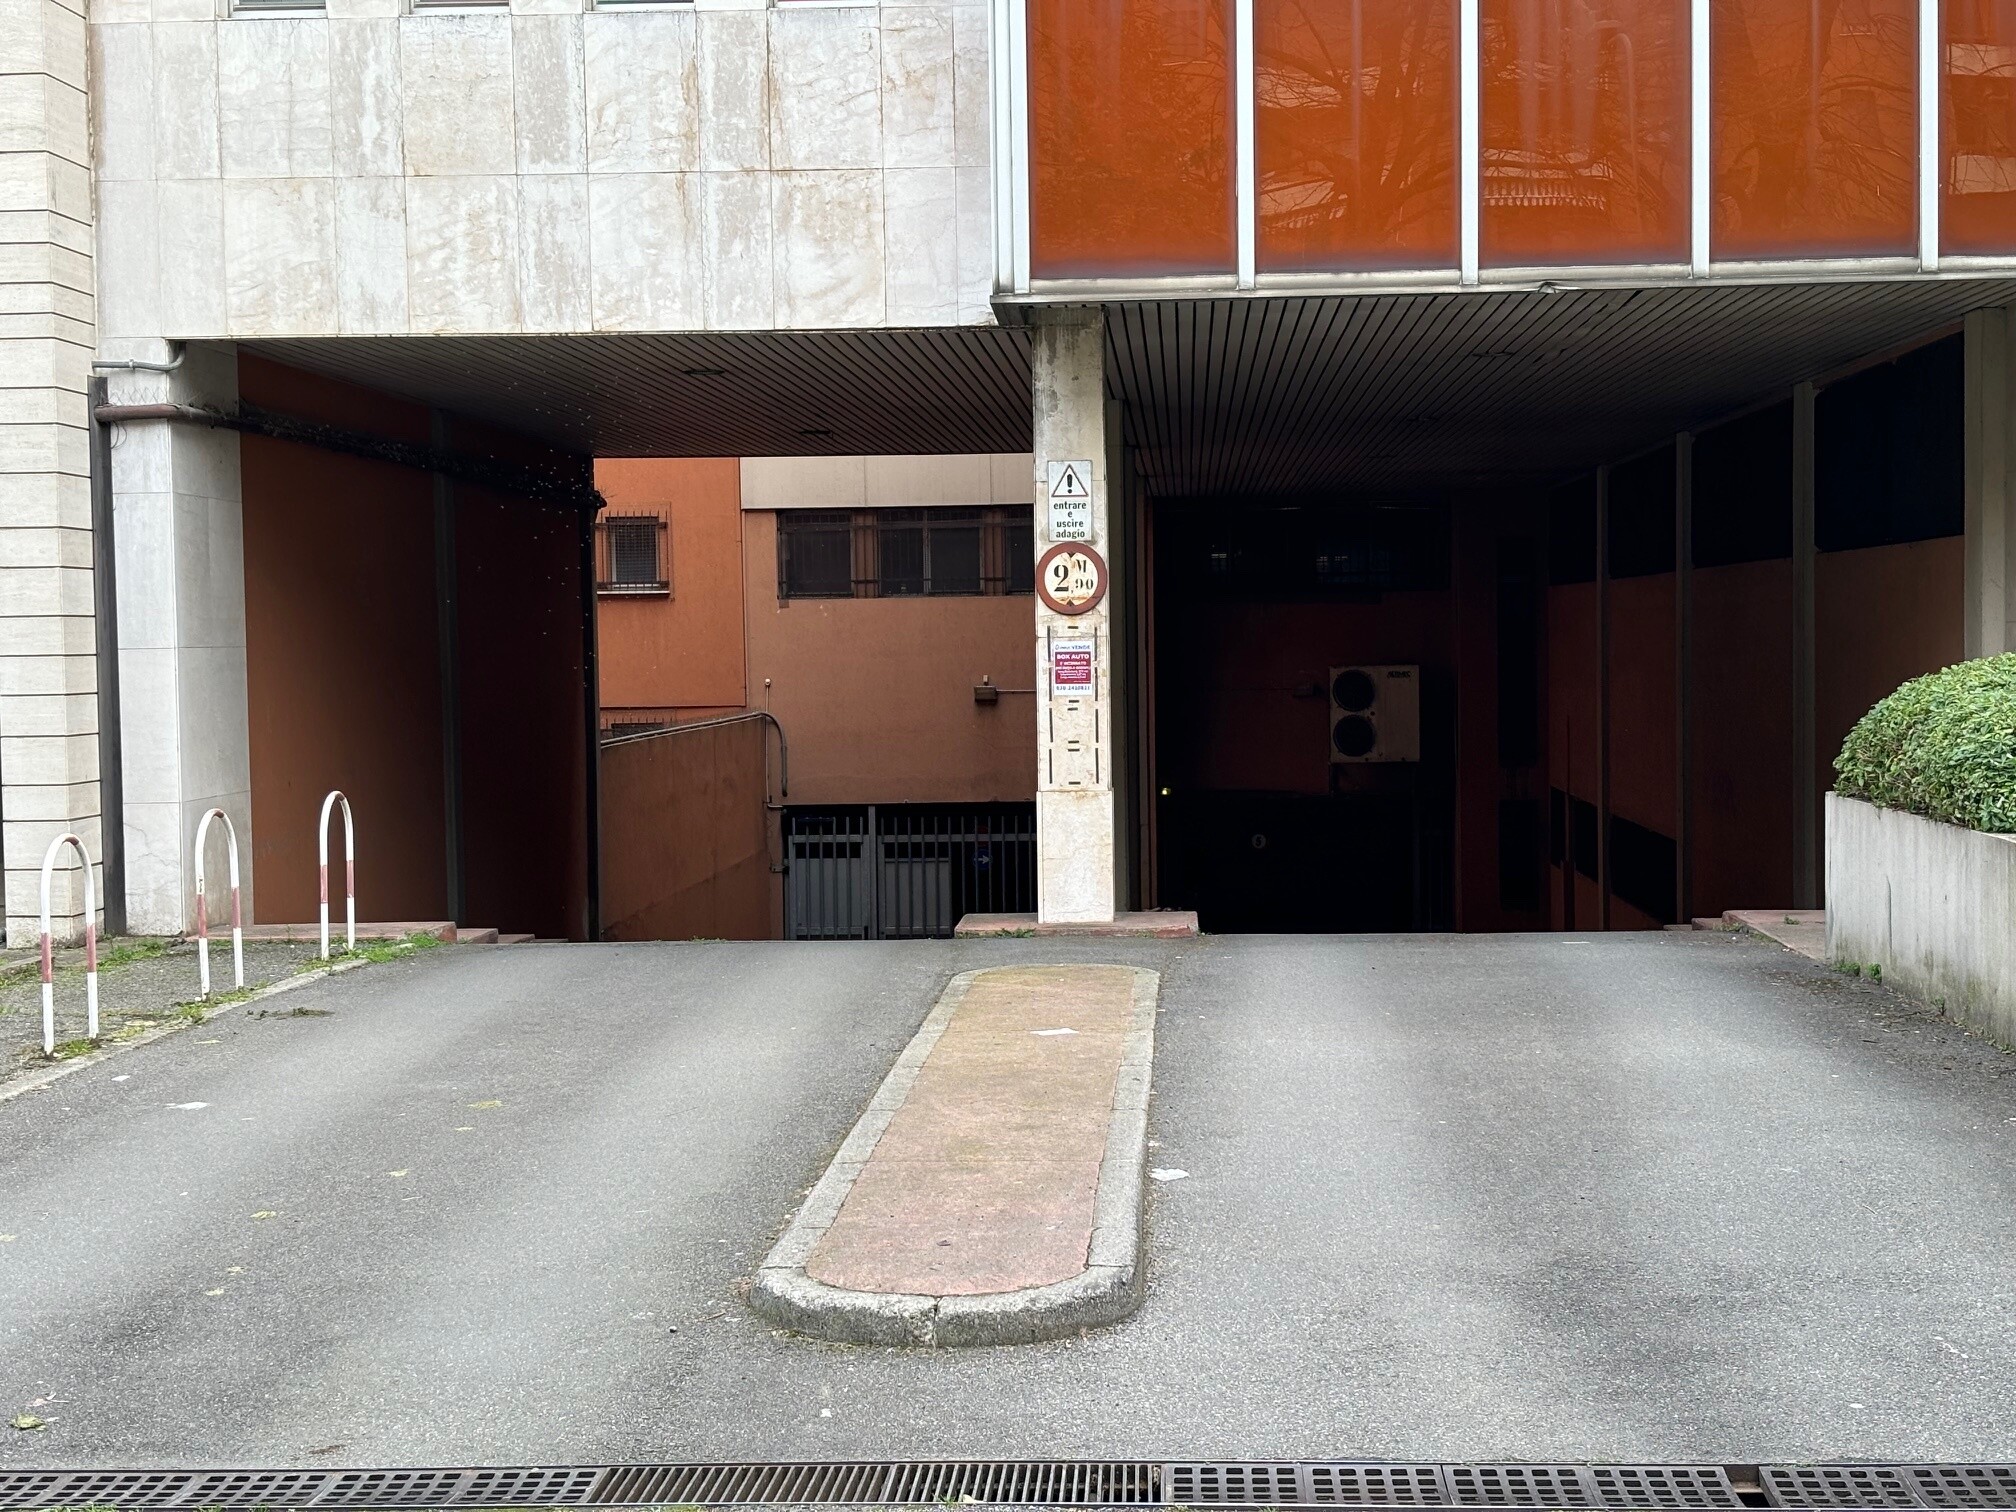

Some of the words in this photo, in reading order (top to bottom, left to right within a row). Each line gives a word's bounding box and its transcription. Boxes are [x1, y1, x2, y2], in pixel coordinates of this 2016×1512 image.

[1053, 501, 1087, 510] entrare
[1056, 519, 1084, 528] uscire
[1055, 529, 1086, 539] adagio
